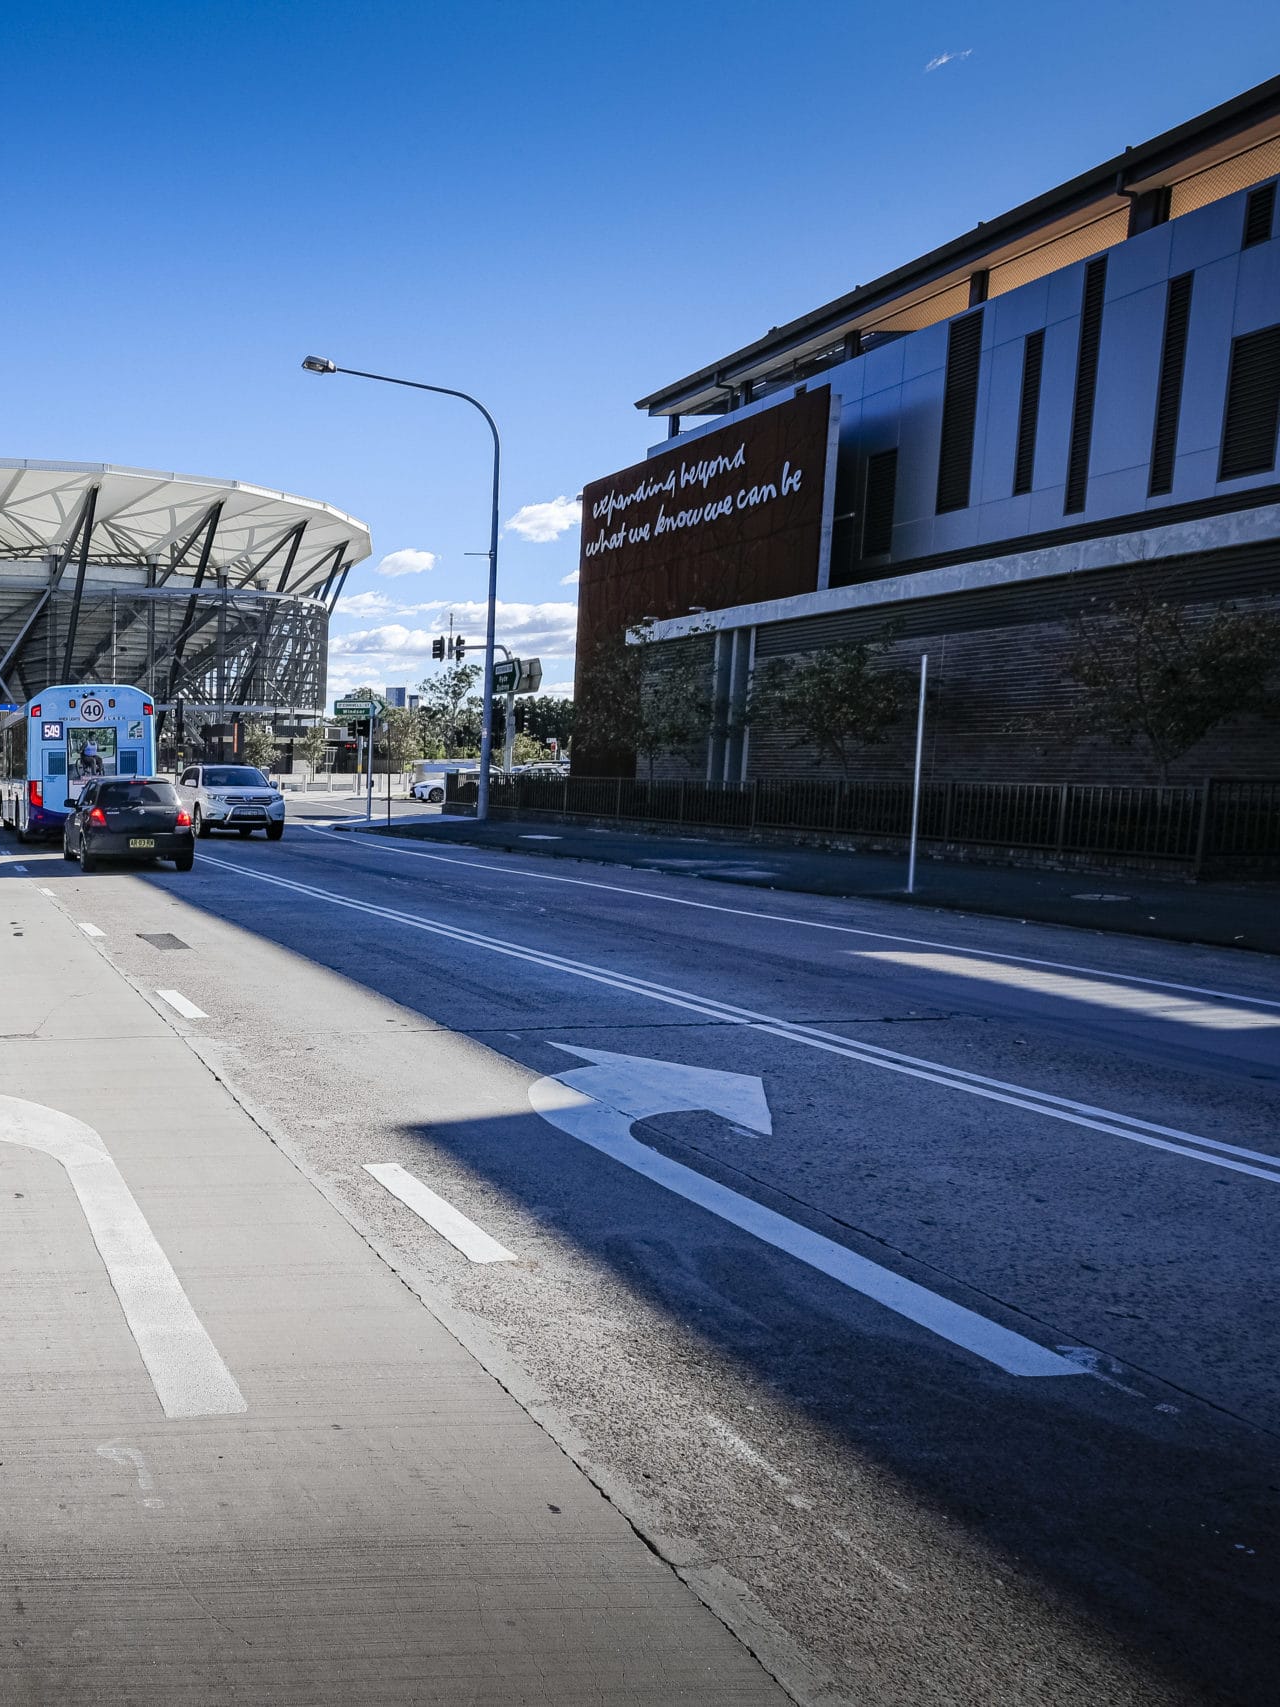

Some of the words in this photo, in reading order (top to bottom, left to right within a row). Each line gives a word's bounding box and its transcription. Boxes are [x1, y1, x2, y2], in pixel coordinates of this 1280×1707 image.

[592, 470, 676, 526] expanding
[680, 442, 746, 489] beyond
[585, 521, 626, 557] what
[629, 522, 650, 544] we
[654, 504, 703, 537] know
[703, 494, 733, 522] we
[737, 483, 777, 510] can
[781, 461, 803, 496] be
[44, 724, 60, 738] 549
[83, 704, 101, 716] 40
